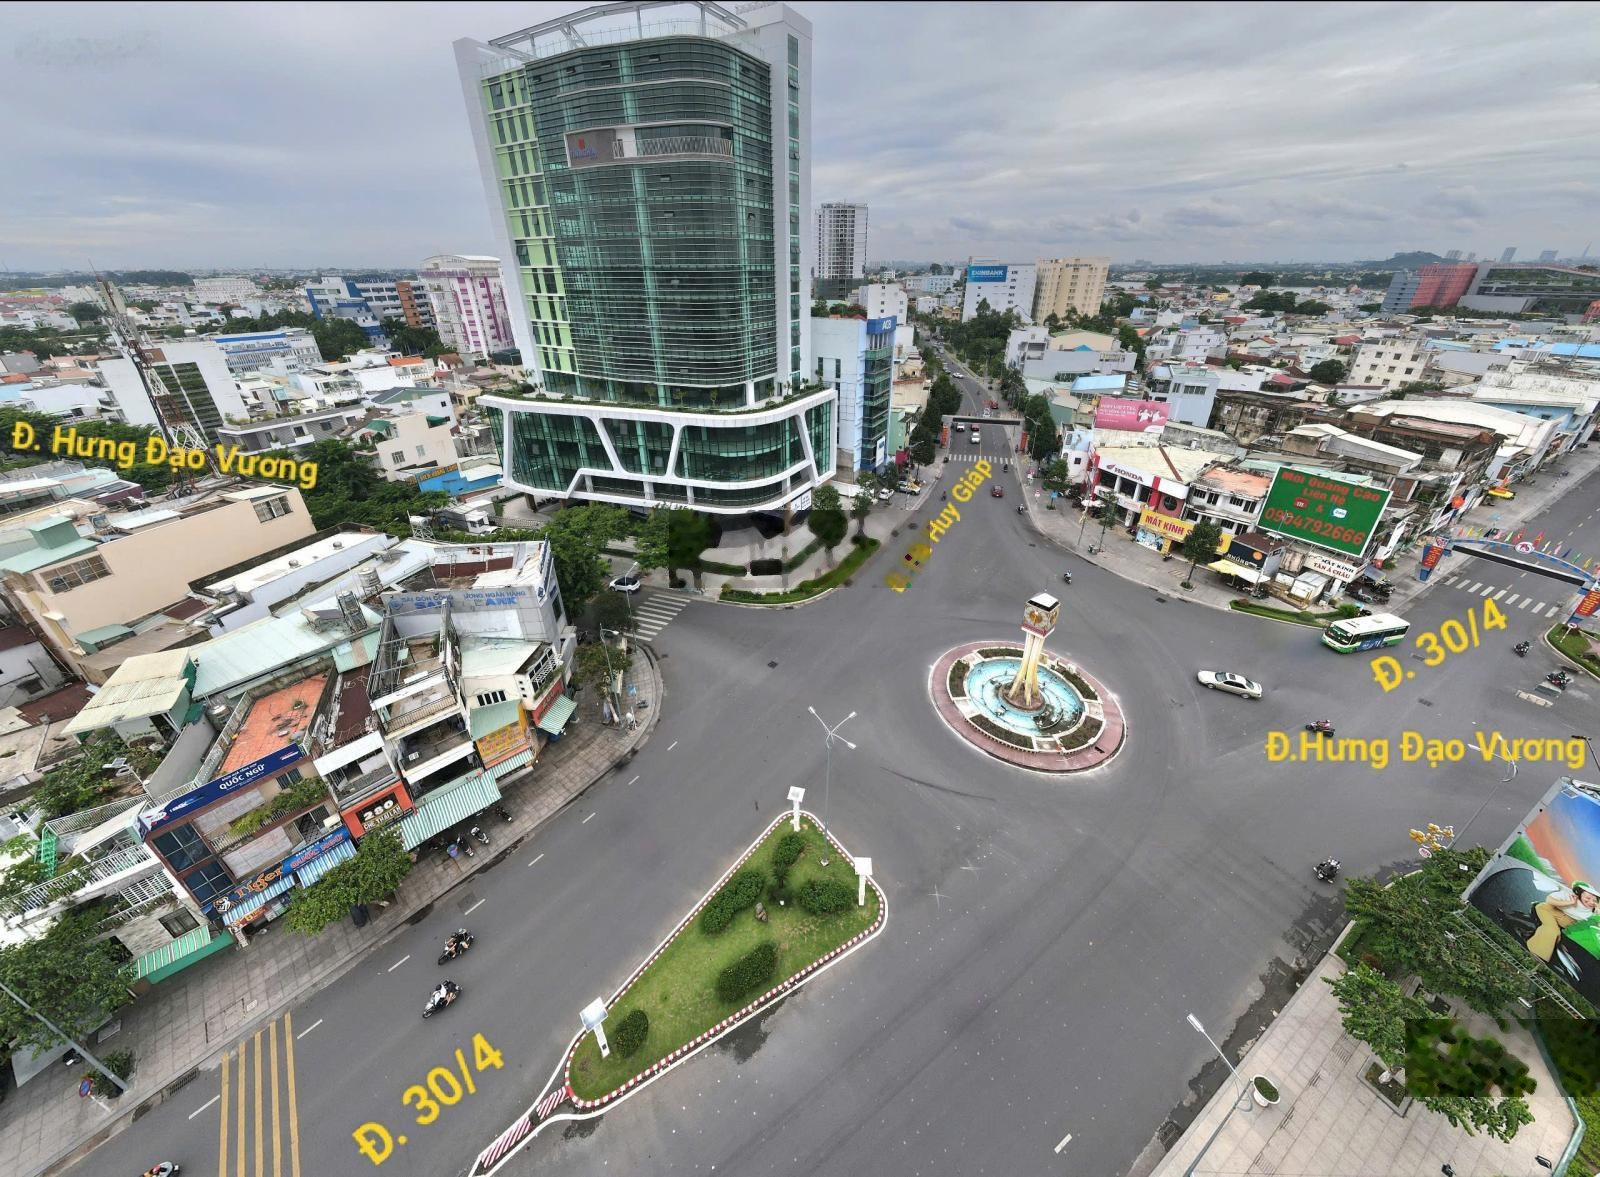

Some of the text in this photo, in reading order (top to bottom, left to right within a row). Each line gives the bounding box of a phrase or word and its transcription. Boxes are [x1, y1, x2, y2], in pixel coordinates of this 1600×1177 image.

[1114, 467, 1143, 482] HONDA
[219, 774, 245, 790] QUỐC
[245, 763, 265, 777] NGỮ
[363, 799, 394, 821] 280
[234, 864, 283, 899] Tiger
